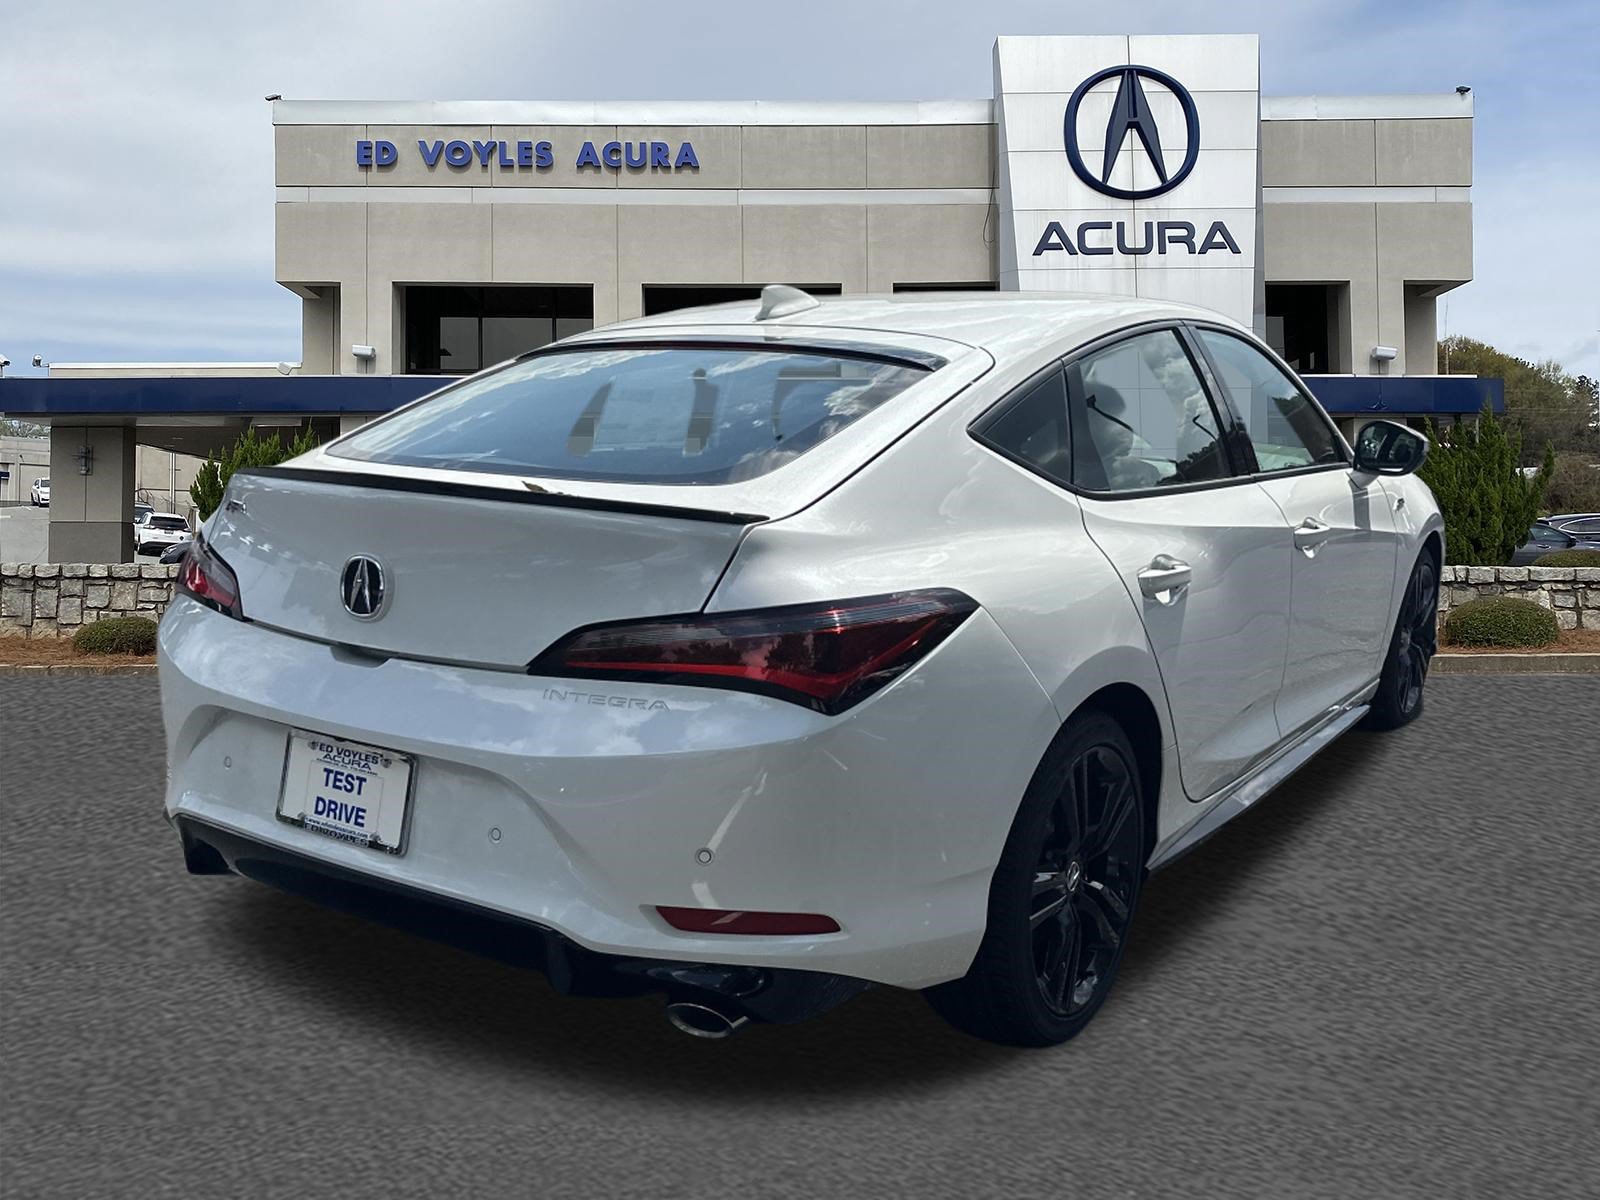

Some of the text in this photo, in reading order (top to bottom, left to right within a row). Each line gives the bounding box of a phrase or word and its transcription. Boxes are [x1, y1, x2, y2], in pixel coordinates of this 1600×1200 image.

[356, 140, 700, 169] ED VOYLES ACURA
[1032, 221, 1242, 256] ACURA
[542, 688, 671, 712] INTEGRA
[319, 743, 379, 765] ED VOYLES
[323, 753, 371, 770] ACURA
[323, 767, 367, 796] TEST
[314, 796, 367, 828] DRIVE
